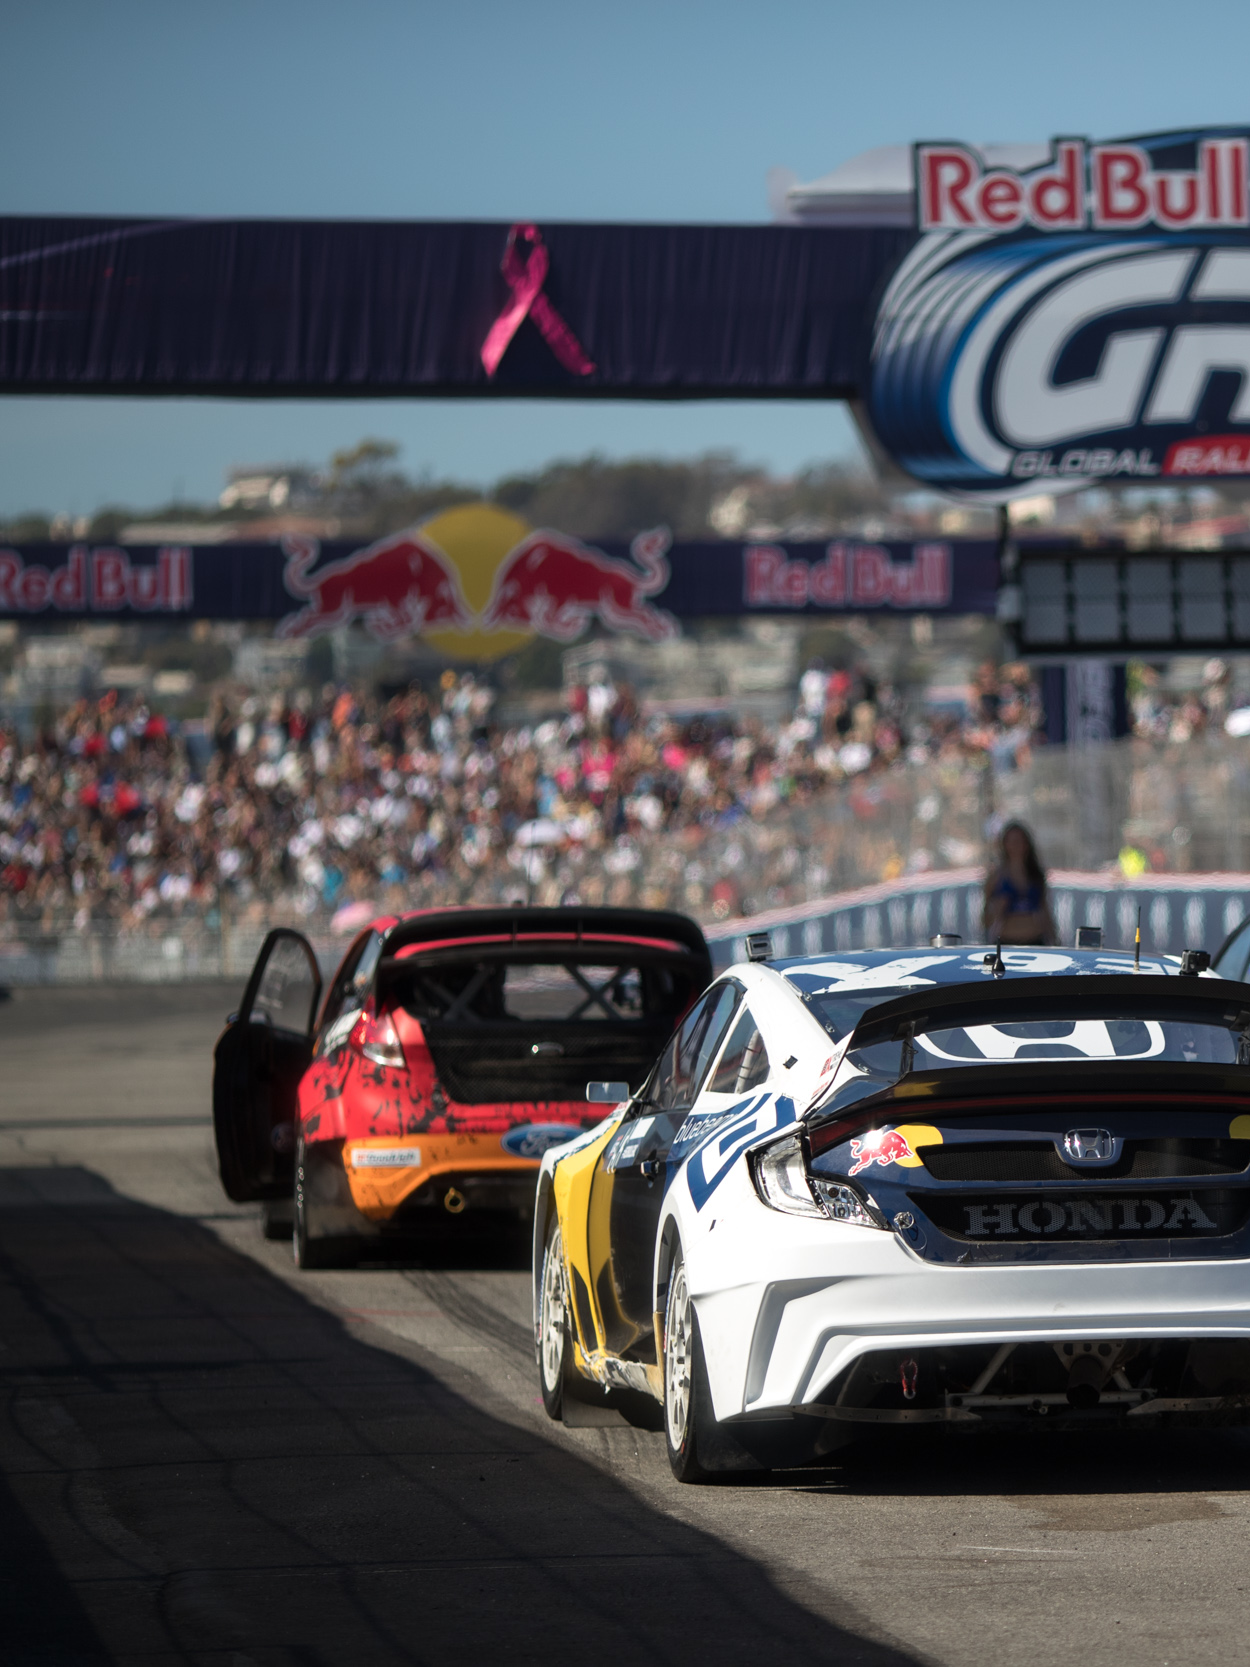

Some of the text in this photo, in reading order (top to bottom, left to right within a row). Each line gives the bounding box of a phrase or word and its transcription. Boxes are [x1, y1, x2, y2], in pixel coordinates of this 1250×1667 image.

[921, 139, 1250, 230] Red Bull
[1012, 449, 1160, 477] GLOBAL
[0, 546, 192, 612] Red Bull
[744, 541, 952, 608] Red Bull
[963, 1198, 1217, 1236] HONDA
